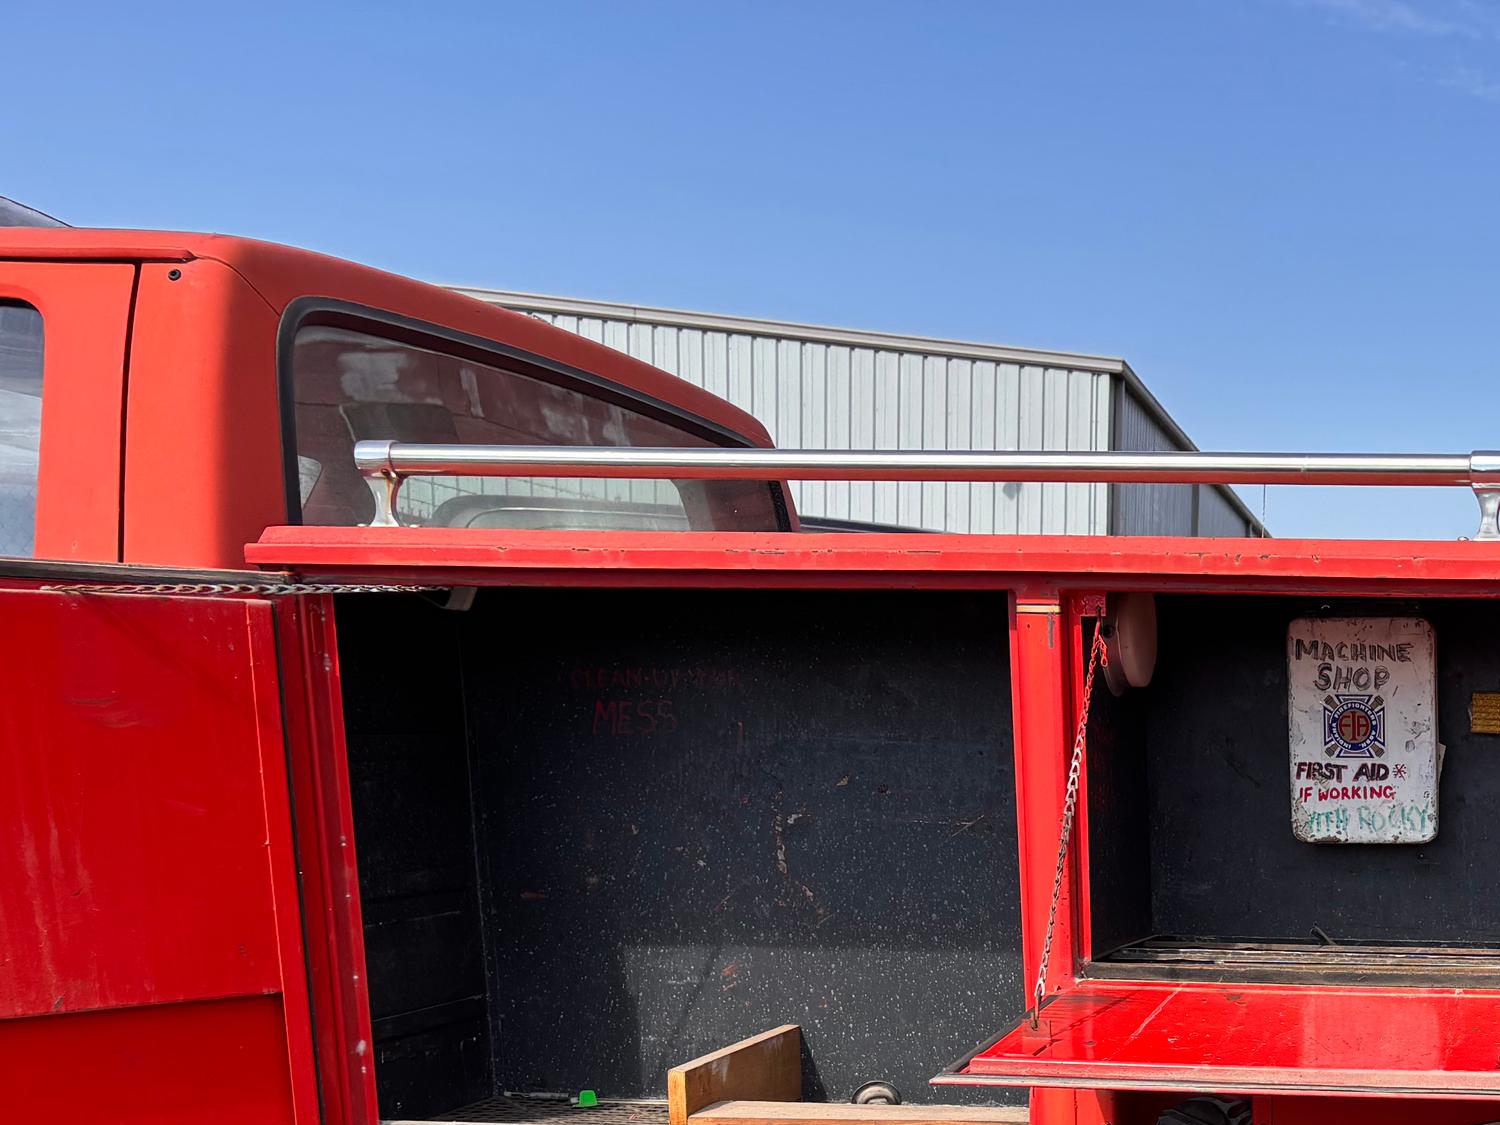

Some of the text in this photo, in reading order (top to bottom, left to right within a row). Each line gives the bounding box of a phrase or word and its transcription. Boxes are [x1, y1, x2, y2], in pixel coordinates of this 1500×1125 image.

[1295, 639, 1412, 663] MACHINE
[1314, 663, 1390, 692] SHOP
[591, 698, 678, 736] MESS
[1332, 722, 1352, 749] INDIANA
[1295, 762, 1390, 784] FIRST AID
[1299, 785, 1397, 803] IF WORKING
[1356, 801, 1430, 833] ROCKY
